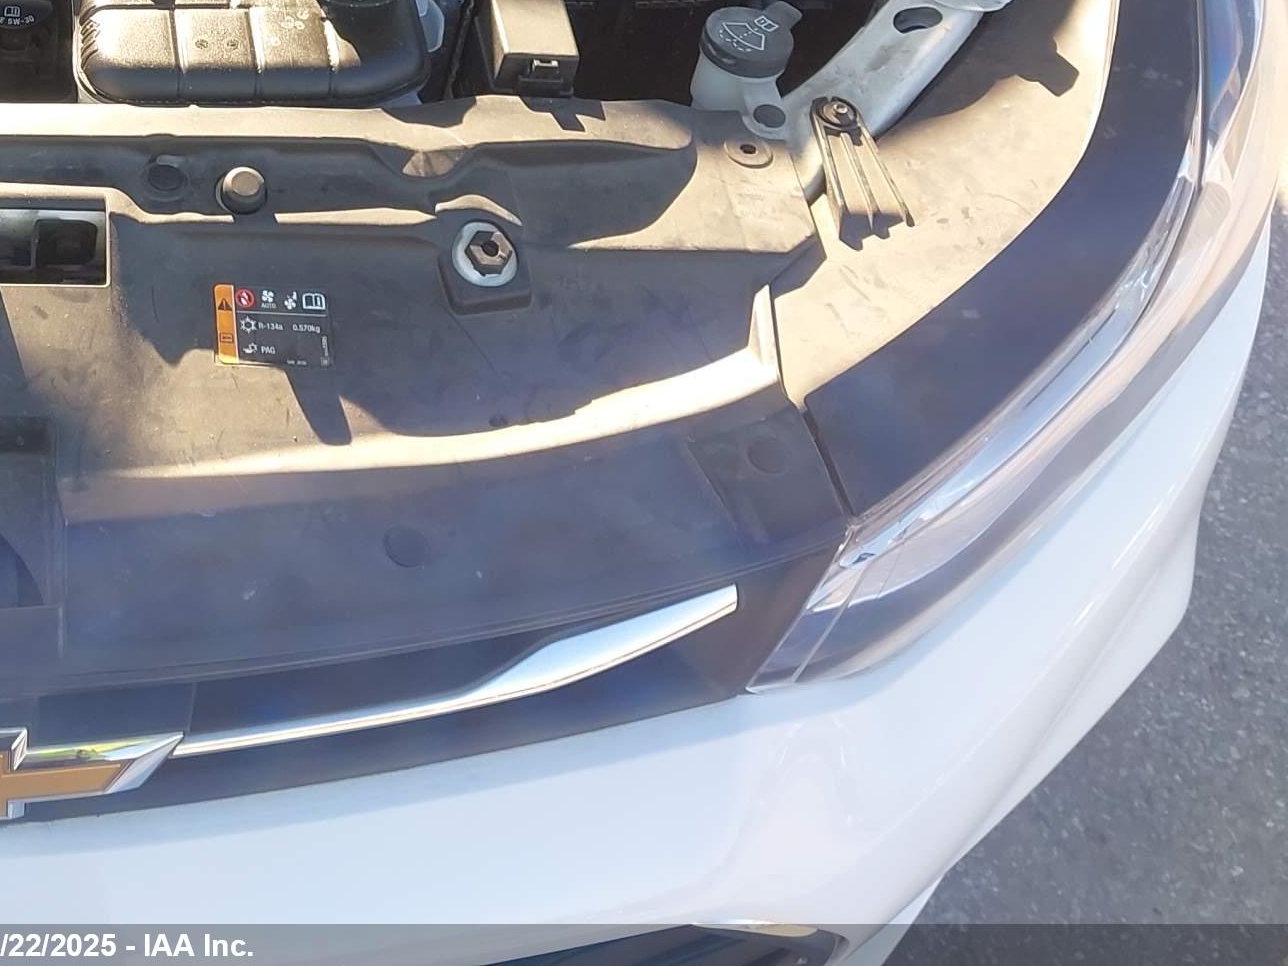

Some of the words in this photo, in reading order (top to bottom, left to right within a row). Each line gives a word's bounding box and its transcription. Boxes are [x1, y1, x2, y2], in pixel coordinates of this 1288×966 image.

[258, 322, 283, 331] R-134a
[292, 324, 320, 334] 0.570kg
[261, 346, 276, 355] PAG
